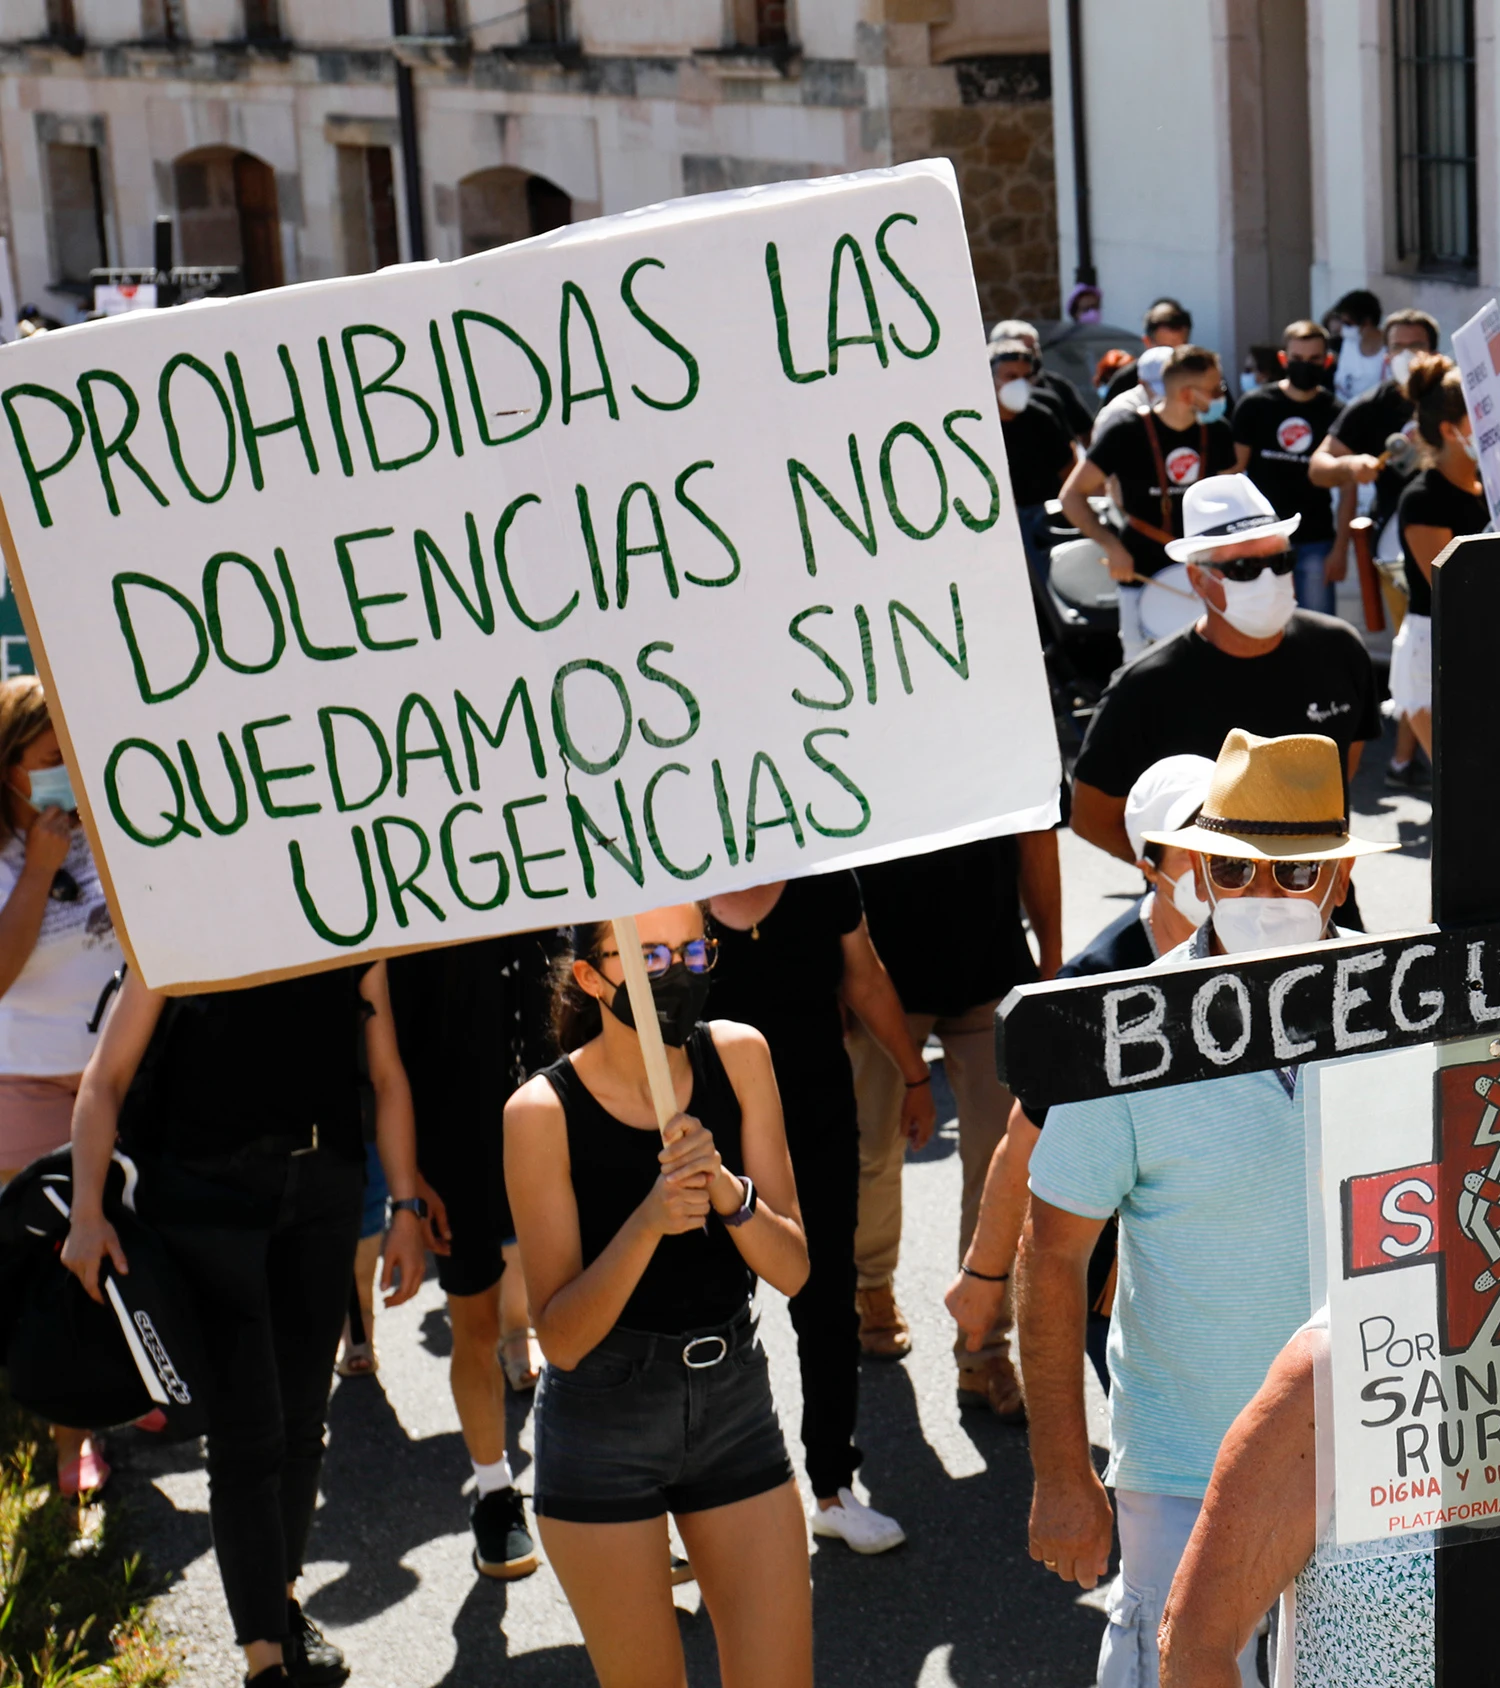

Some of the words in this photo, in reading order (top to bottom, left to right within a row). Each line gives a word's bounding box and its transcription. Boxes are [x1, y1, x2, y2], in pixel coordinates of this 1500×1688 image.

[1, 257, 700, 527] PROHIBIDAS
[764, 212, 941, 384] LAS
[113, 459, 741, 704] DOLENCIAS
[787, 409, 1001, 575] NOS
[103, 639, 701, 846] QUEDAMOS
[789, 583, 969, 711] SIN
[289, 727, 871, 946] URGENCIAS
[1457, 1469, 1469, 1491] Y
